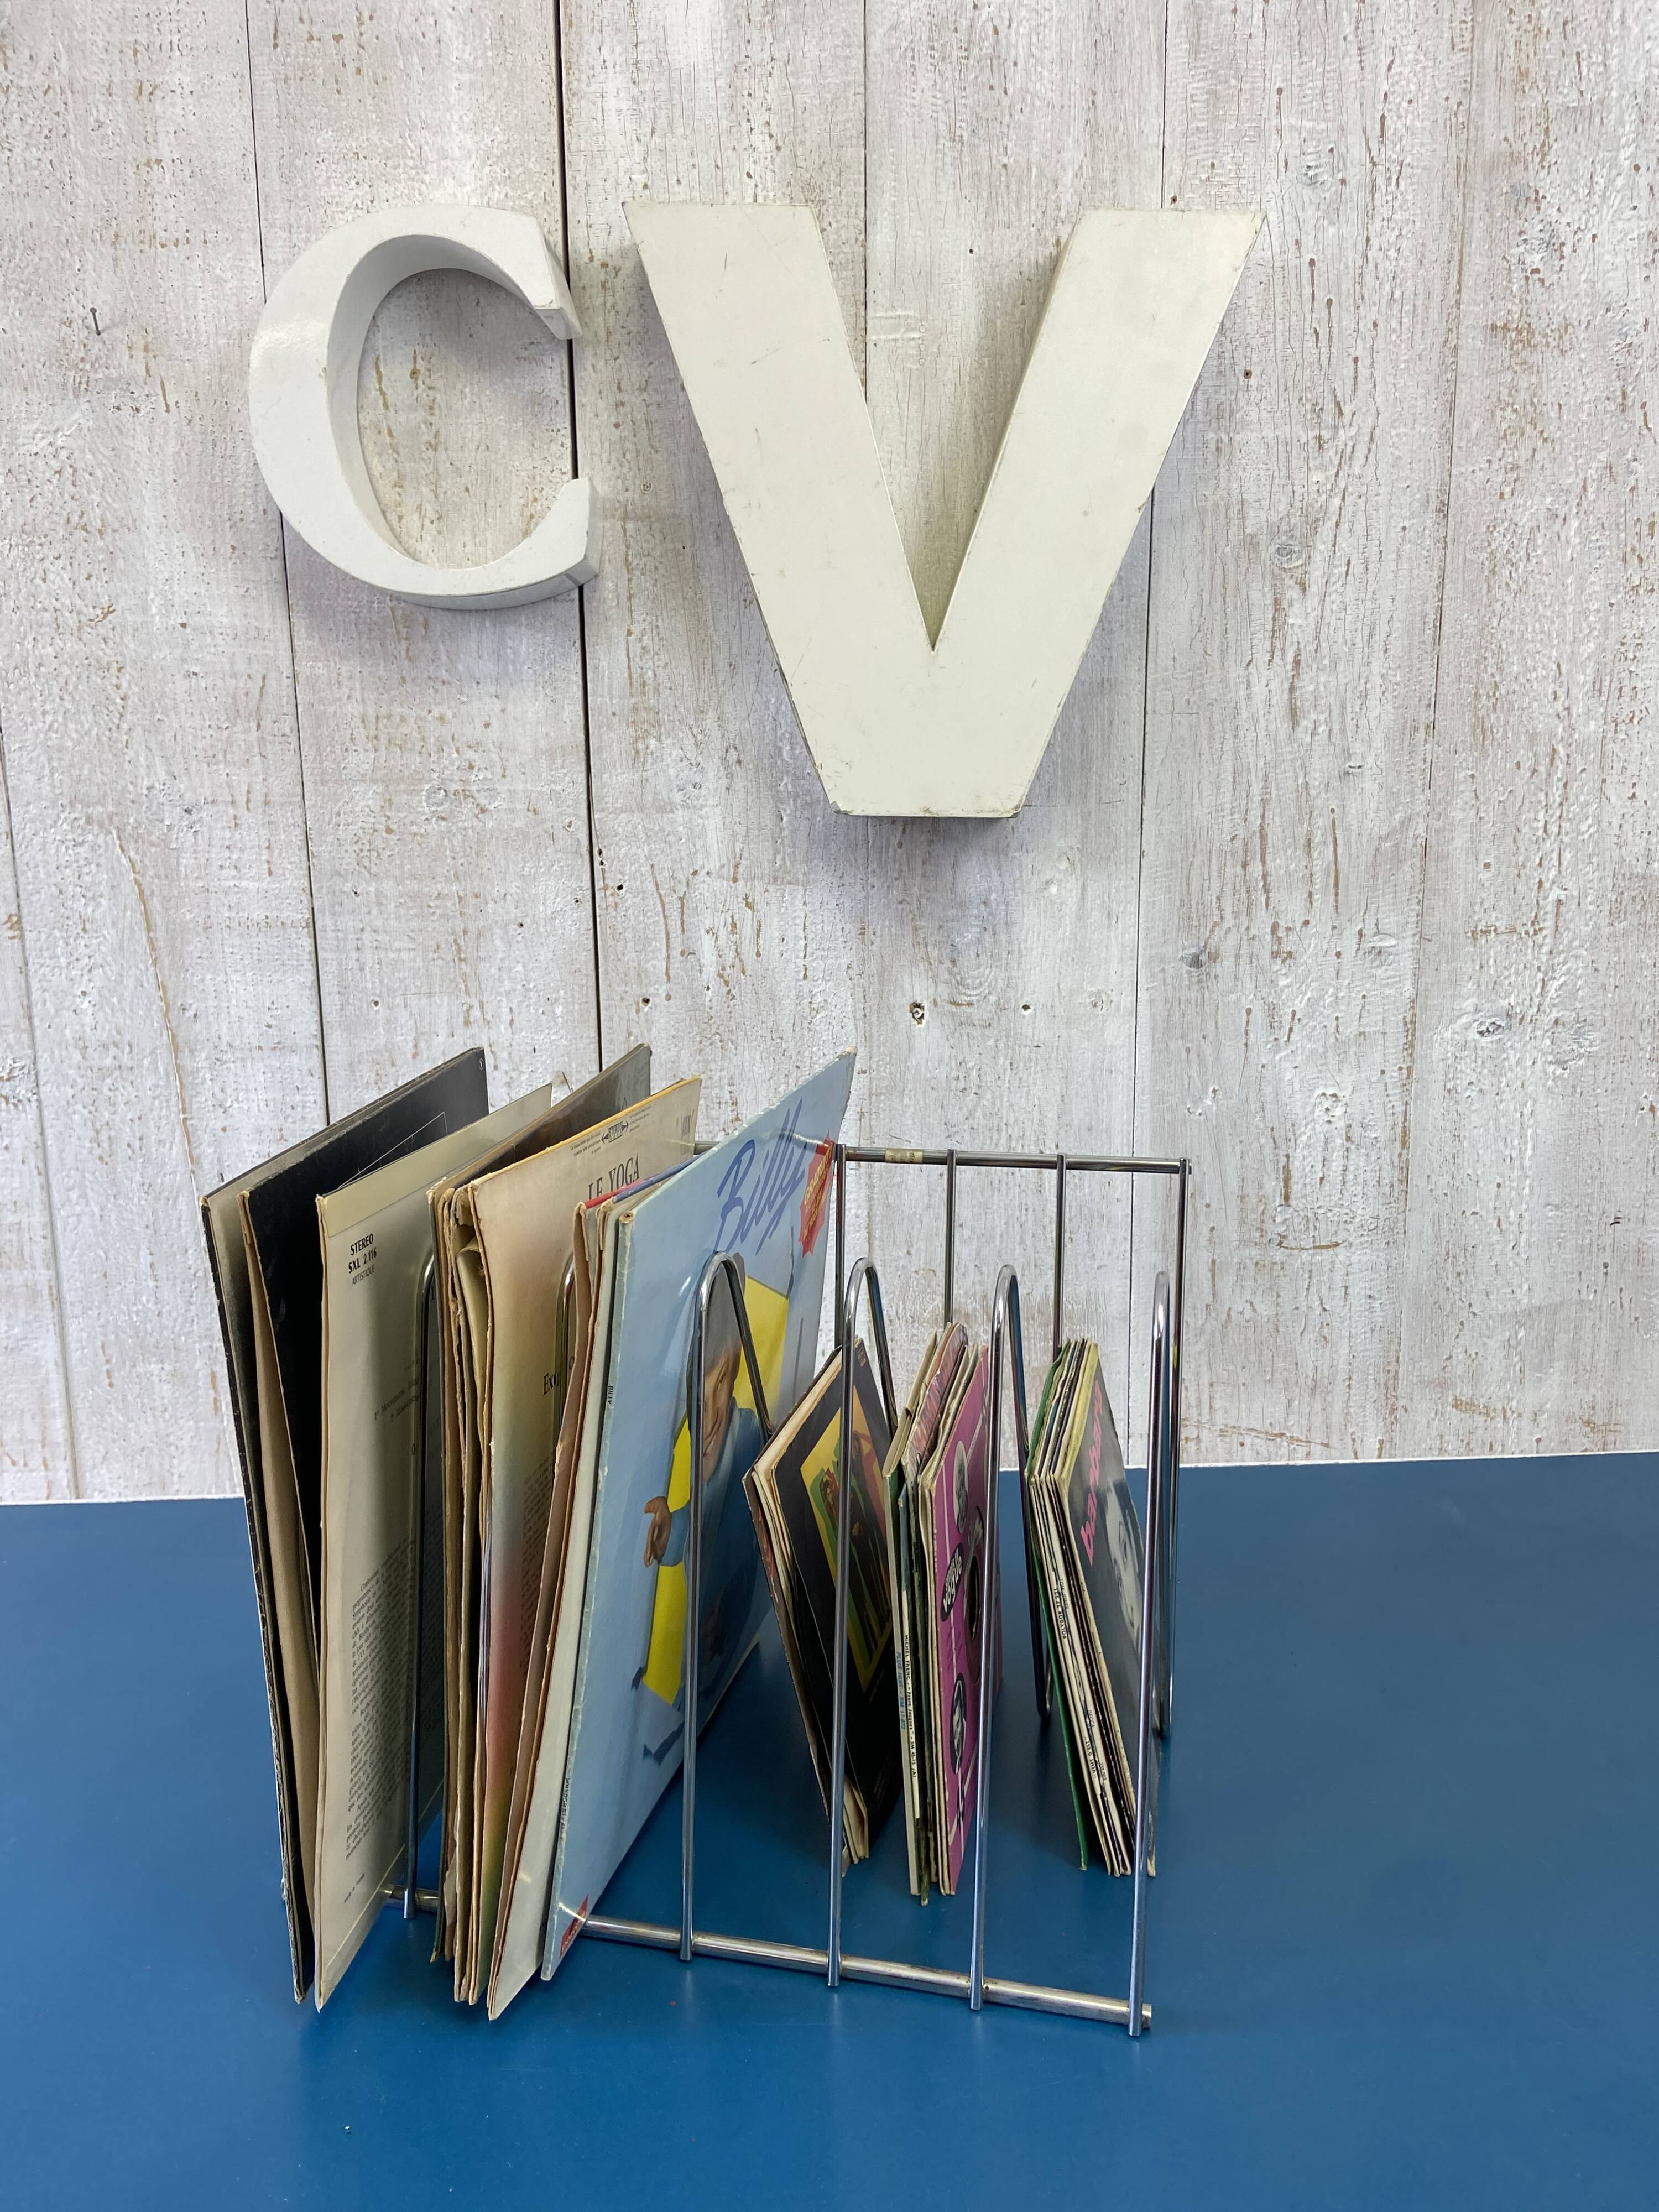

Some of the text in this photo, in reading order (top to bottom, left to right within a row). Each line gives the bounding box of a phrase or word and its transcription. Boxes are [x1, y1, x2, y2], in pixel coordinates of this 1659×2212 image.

[249, 201, 1266, 818] C V
[608, 1152, 640, 1193] YOGA
[713, 1097, 805, 1256] Billy
[351, 1233, 374, 1256] STEREO
[348, 1258, 361, 1274] SXL
[352, 1264, 375, 1285] ARTISTIQUE
[1081, 1380, 1102, 1567] barbara
[943, 1556, 962, 1613] vogue
[1058, 1611, 1067, 1639] POLYDOR
